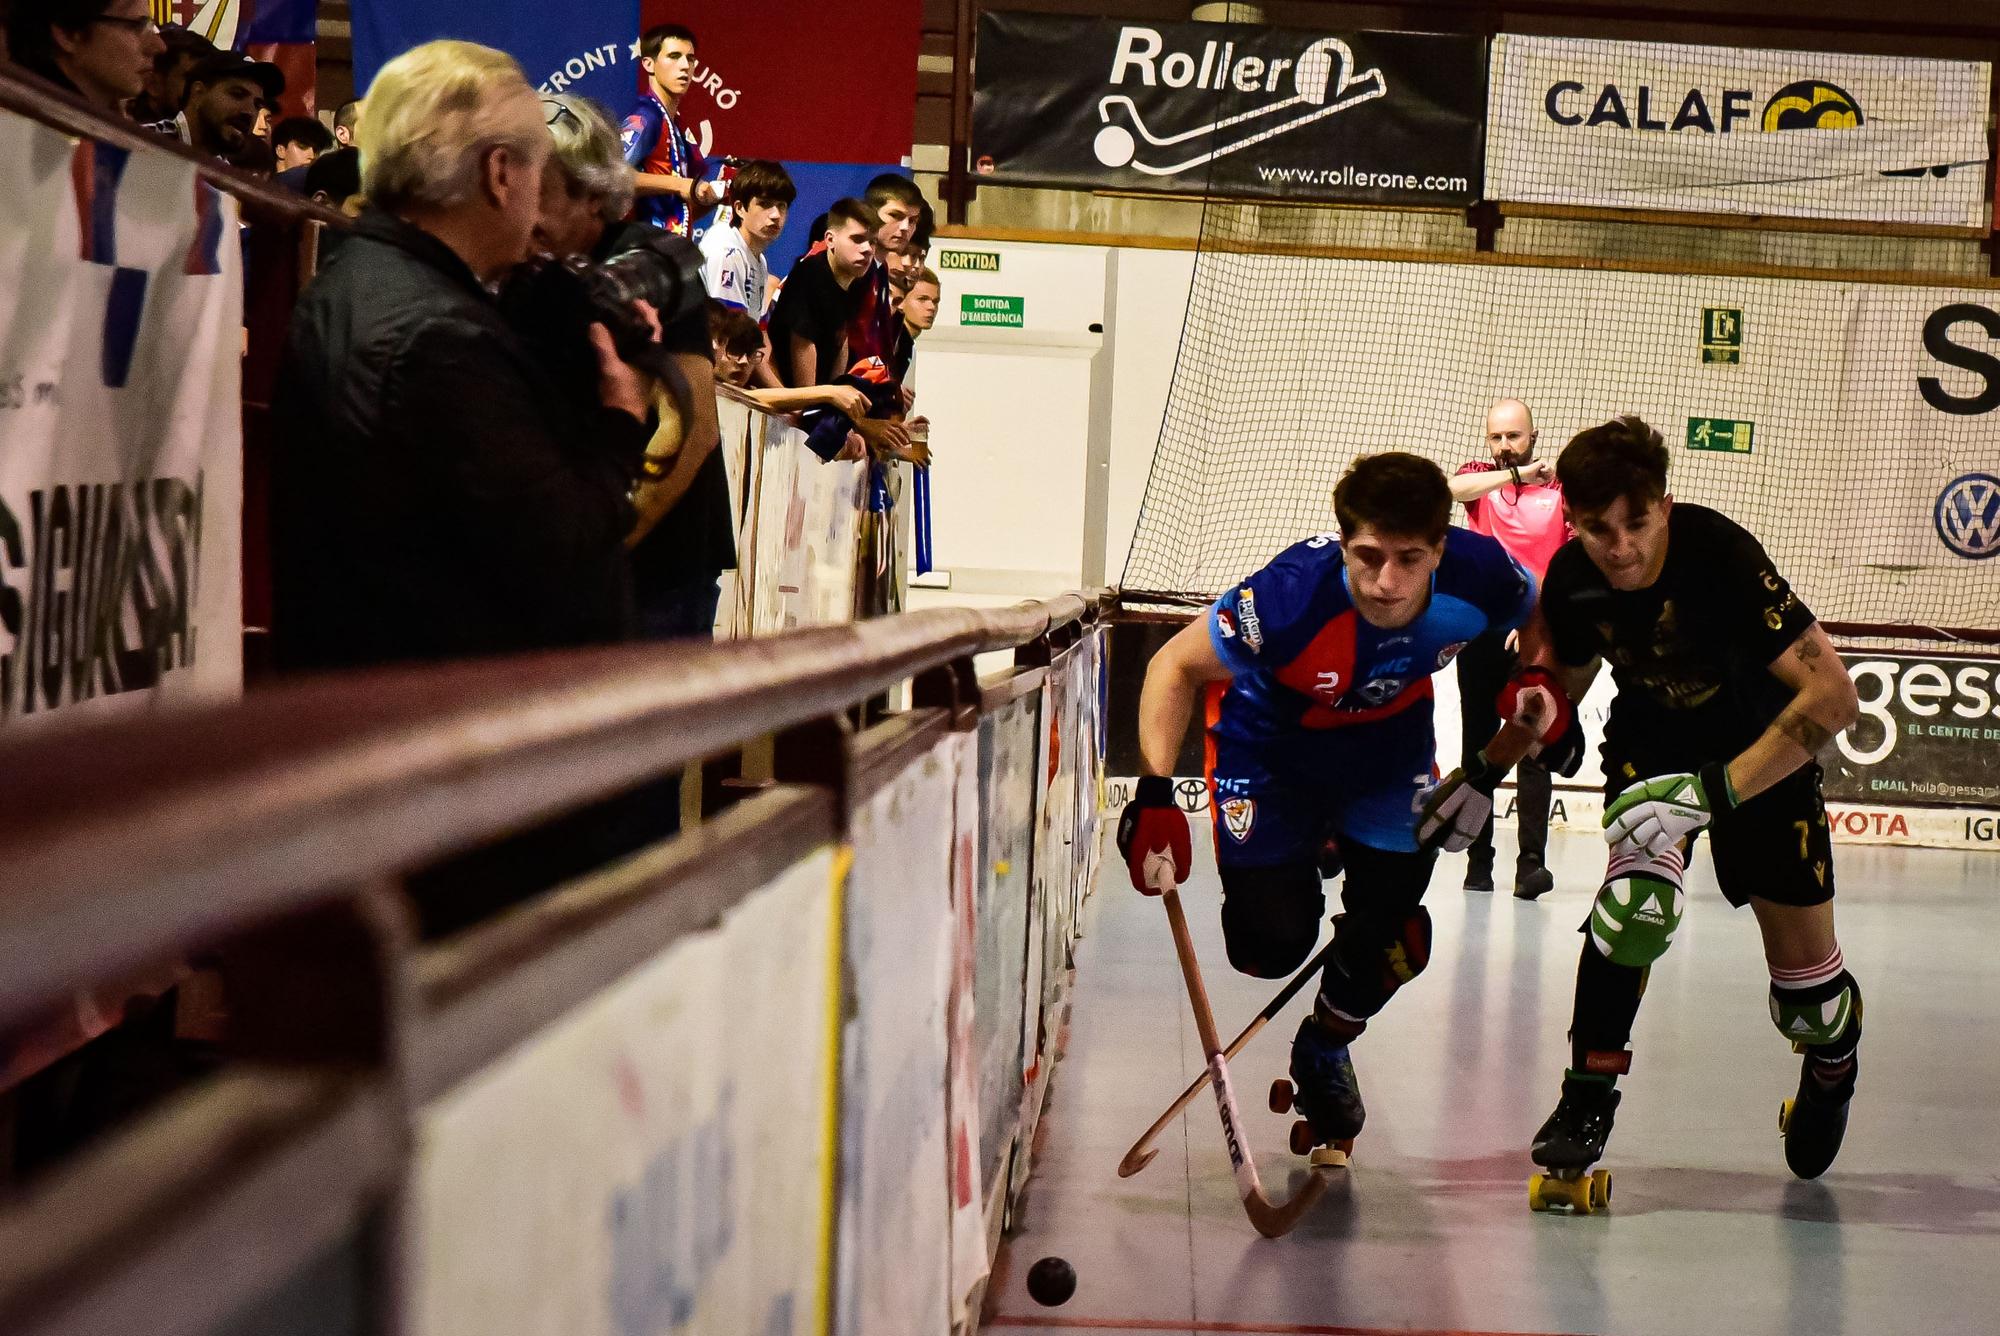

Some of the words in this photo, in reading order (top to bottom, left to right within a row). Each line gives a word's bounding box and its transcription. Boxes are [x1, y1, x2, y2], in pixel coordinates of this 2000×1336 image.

[1545, 80, 1754, 133] CALAF
[1258, 165, 1468, 192] www.rollerone.com
[942, 252, 998, 270] SORTIDA
[974, 298, 1011, 310] SORTIDA
[1917, 304, 2000, 415] S
[1836, 661, 2000, 765] ges
[1908, 724, 1924, 735] EL
[1928, 725, 1980, 740] CENTRE
[1871, 779, 1909, 793] EMAIL
[1964, 816, 2000, 842] IG
